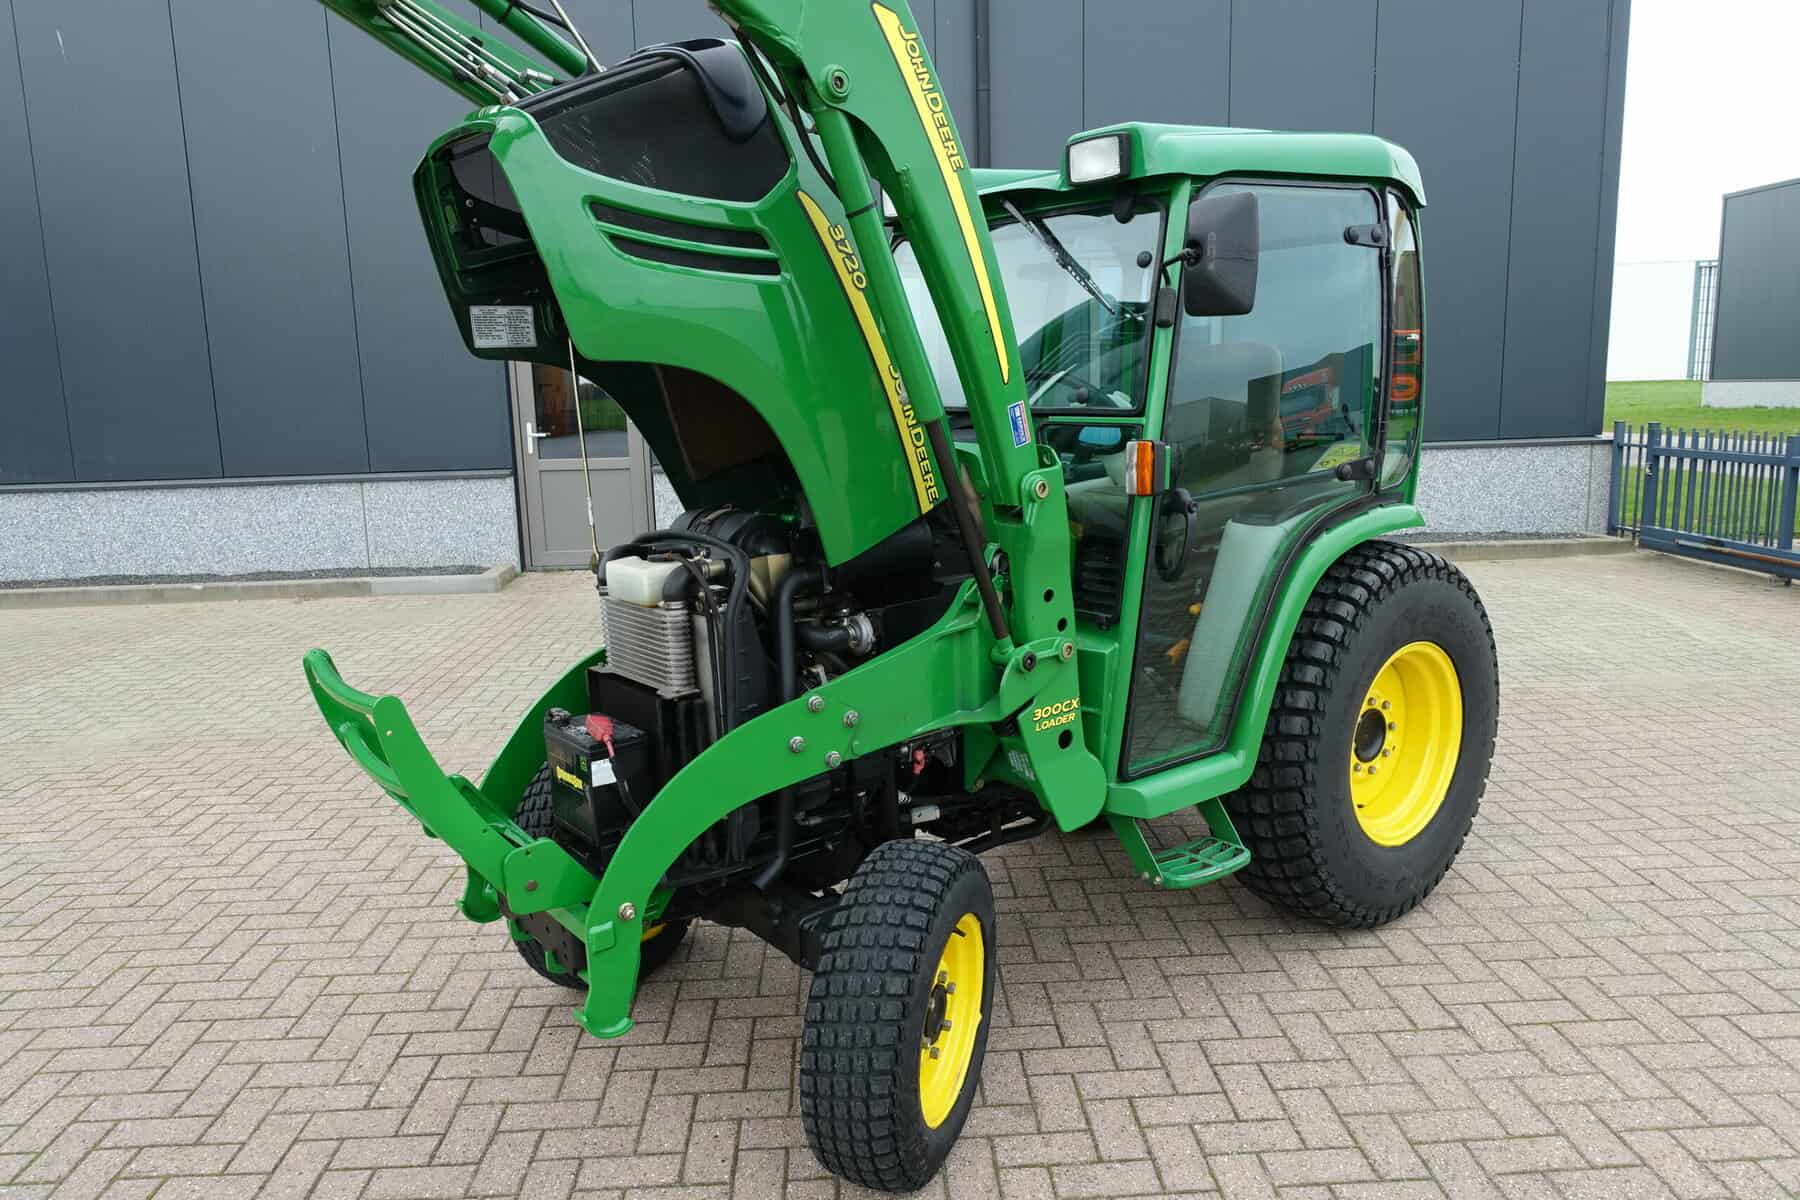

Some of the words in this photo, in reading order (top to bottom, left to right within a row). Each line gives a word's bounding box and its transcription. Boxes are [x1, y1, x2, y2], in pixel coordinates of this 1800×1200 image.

[898, 24, 934, 93] JOHN
[925, 91, 964, 173] DEERE
[828, 224, 867, 291] 3720
[910, 425, 939, 504] DEERE
[1032, 698, 1079, 721] 300CX
[1035, 713, 1076, 732] LOADER
